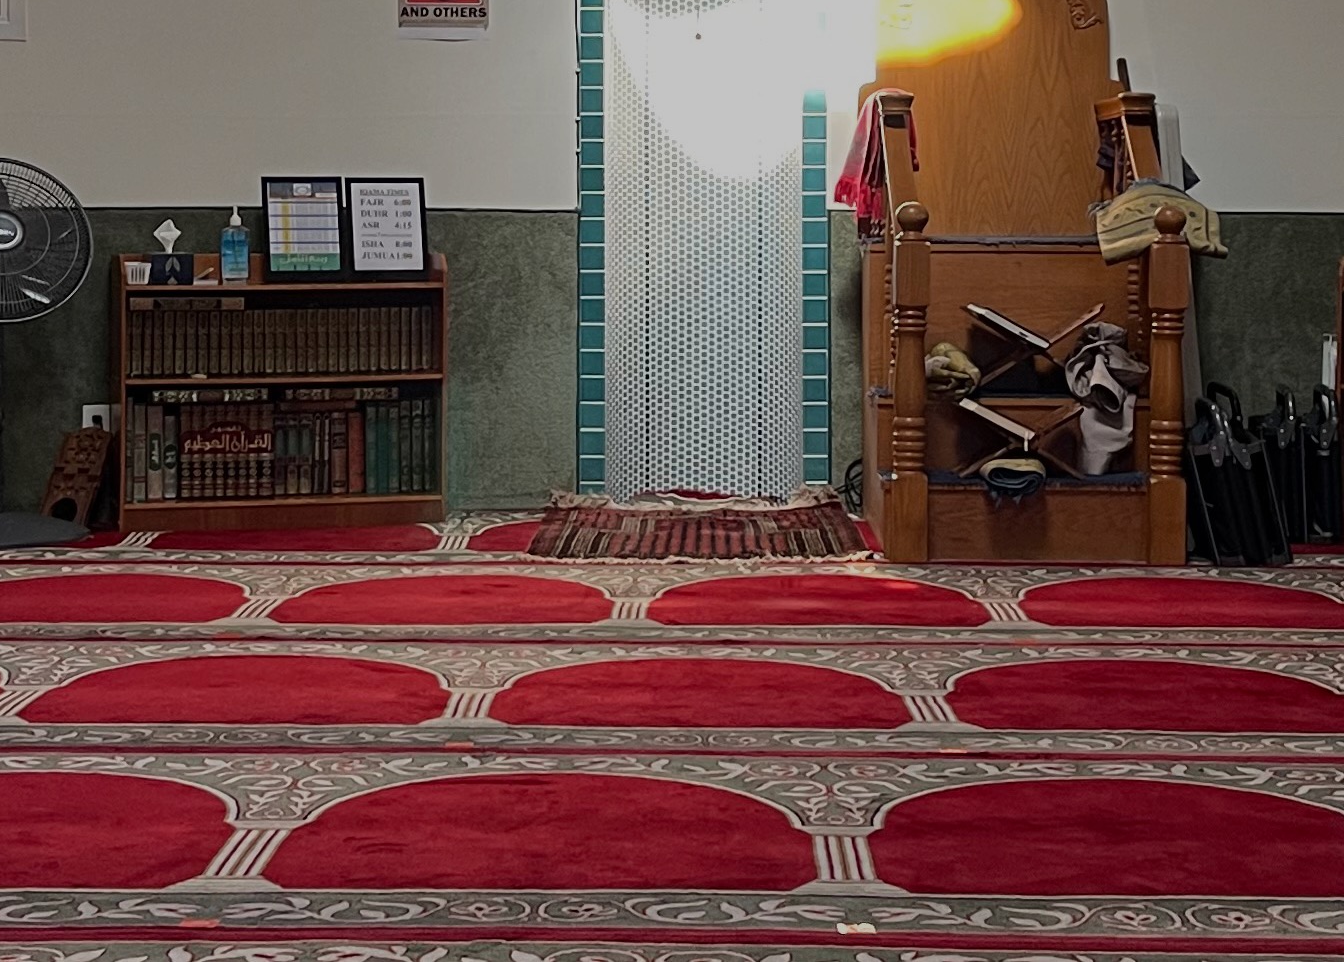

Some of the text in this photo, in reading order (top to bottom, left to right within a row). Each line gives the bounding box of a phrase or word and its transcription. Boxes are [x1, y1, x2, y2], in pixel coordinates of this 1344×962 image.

[400, 6, 487, 18] AND OTHERS
[360, 198, 384, 206] FAJR
[361, 240, 384, 248] ISHA
[184, 433, 230, 453] العظيم
